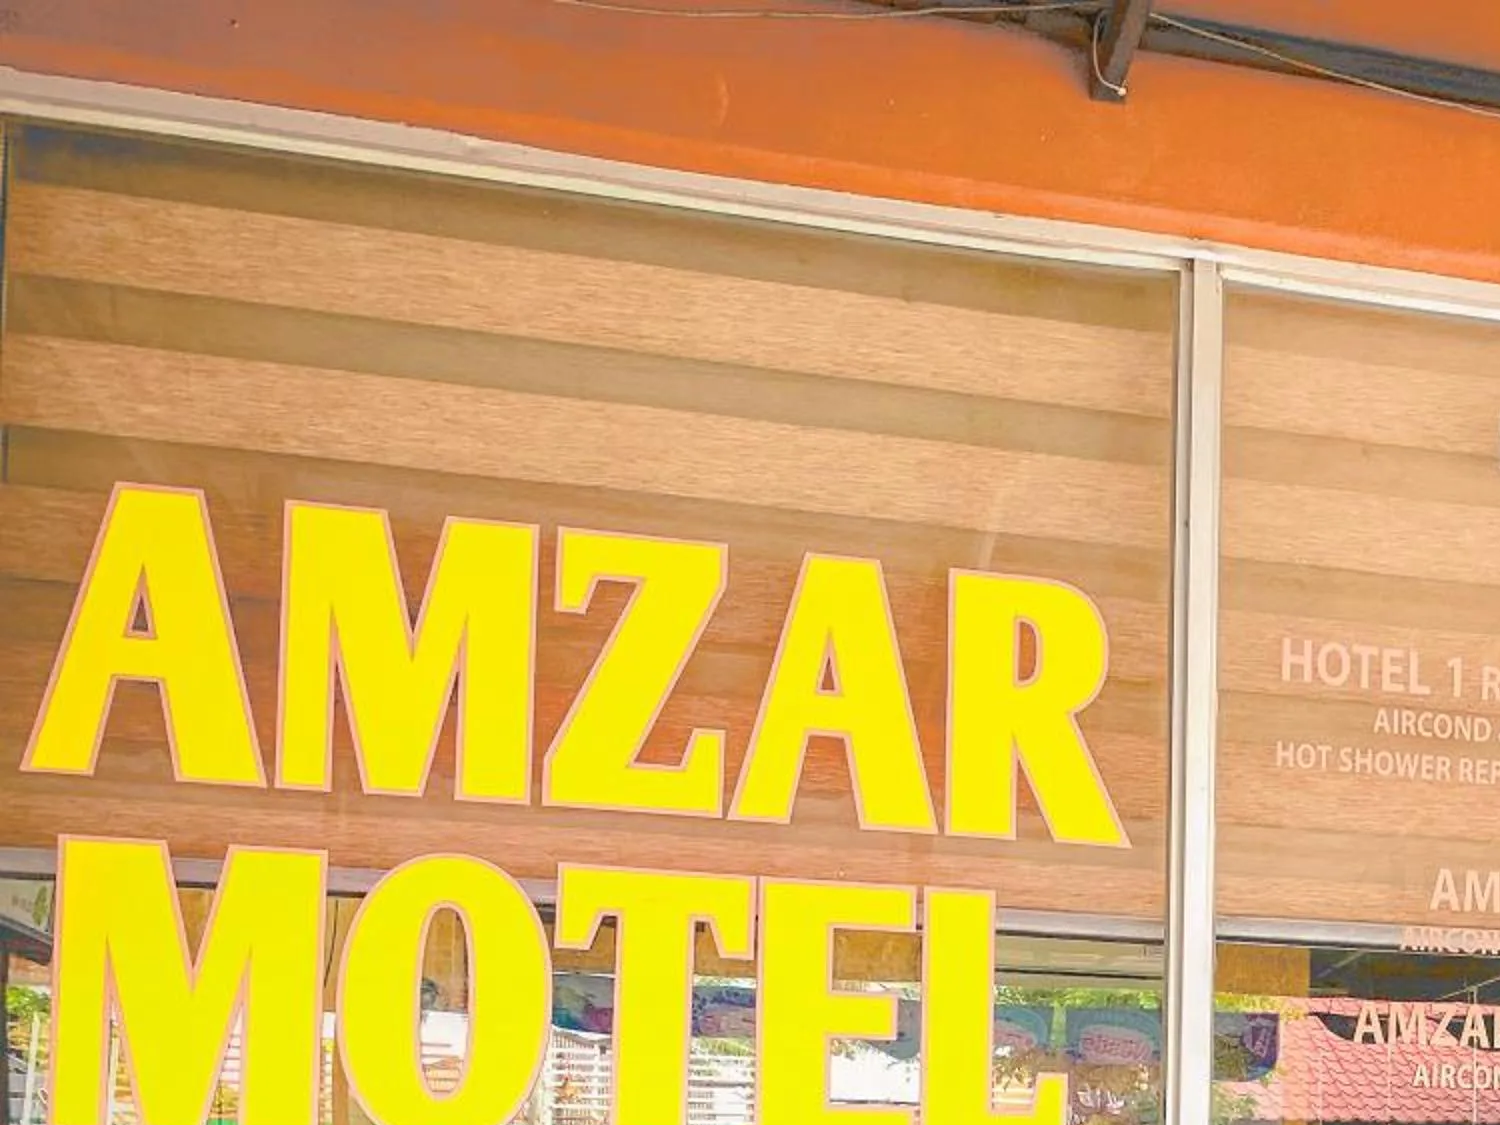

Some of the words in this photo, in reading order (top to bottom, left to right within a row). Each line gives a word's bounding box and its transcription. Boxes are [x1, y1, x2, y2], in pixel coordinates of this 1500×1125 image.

[20, 481, 1132, 848] AMZAR
[1281, 638, 1431, 695] HOTEL
[1447, 657, 1463, 697] 1
[1373, 708, 1493, 743] AIRCOND
[1276, 740, 1332, 769] HOT
[1338, 748, 1451, 782] SHOWER
